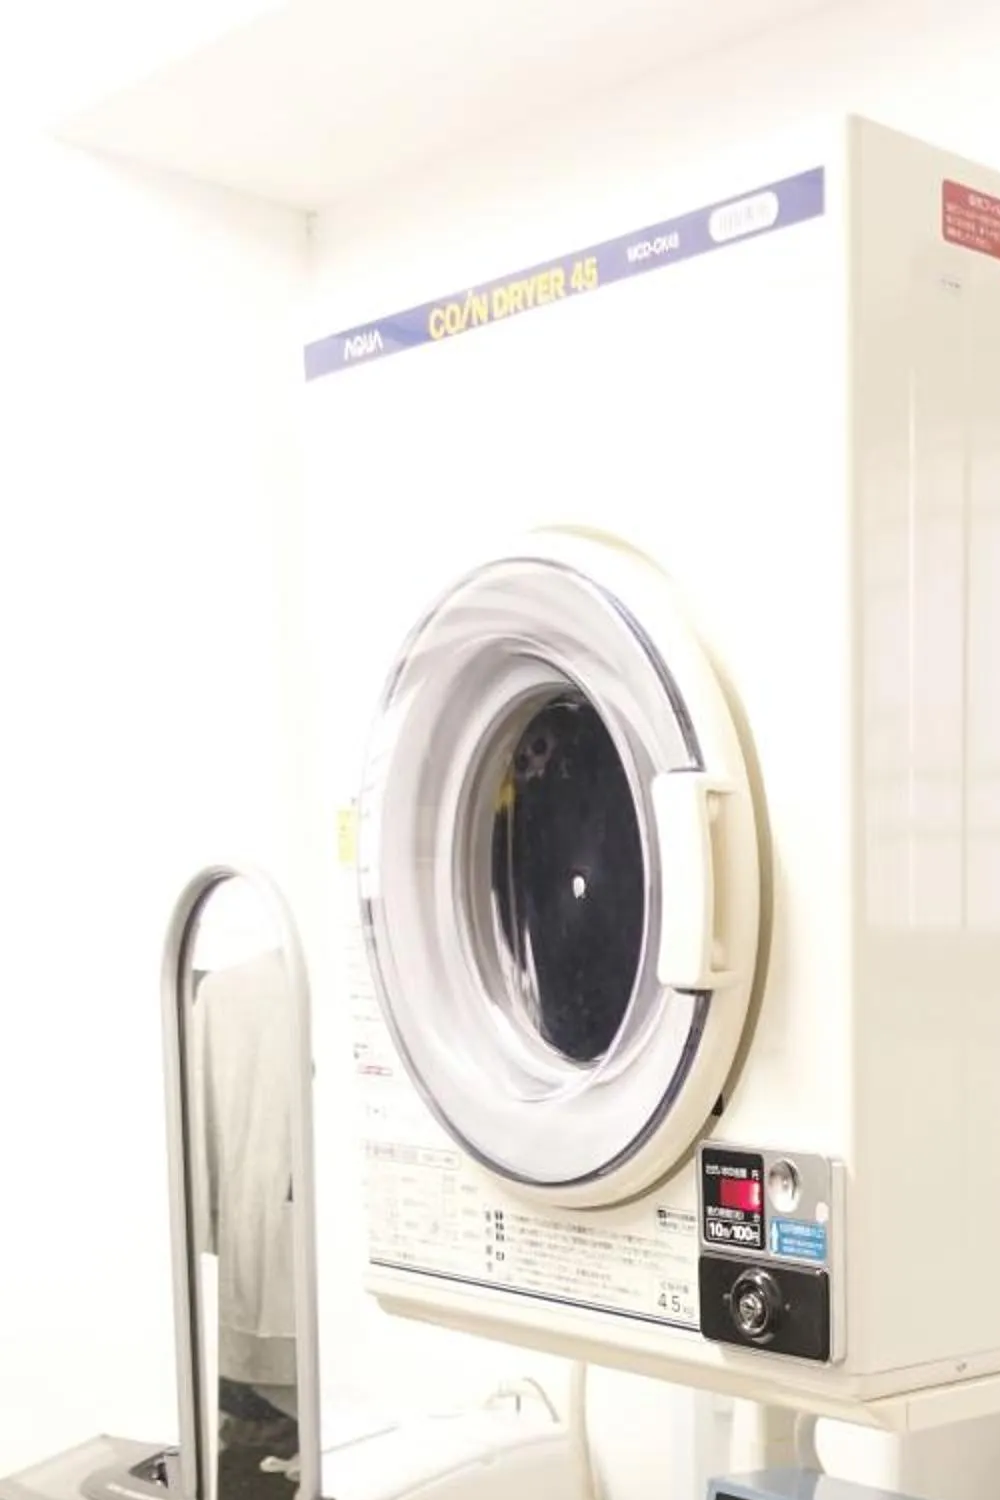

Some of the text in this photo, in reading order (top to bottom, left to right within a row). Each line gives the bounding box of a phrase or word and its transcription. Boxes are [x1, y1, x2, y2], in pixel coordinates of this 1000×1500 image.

[344, 328, 384, 361] AQUA
[492, 268, 565, 319] DRYER
[571, 256, 599, 291] 45
